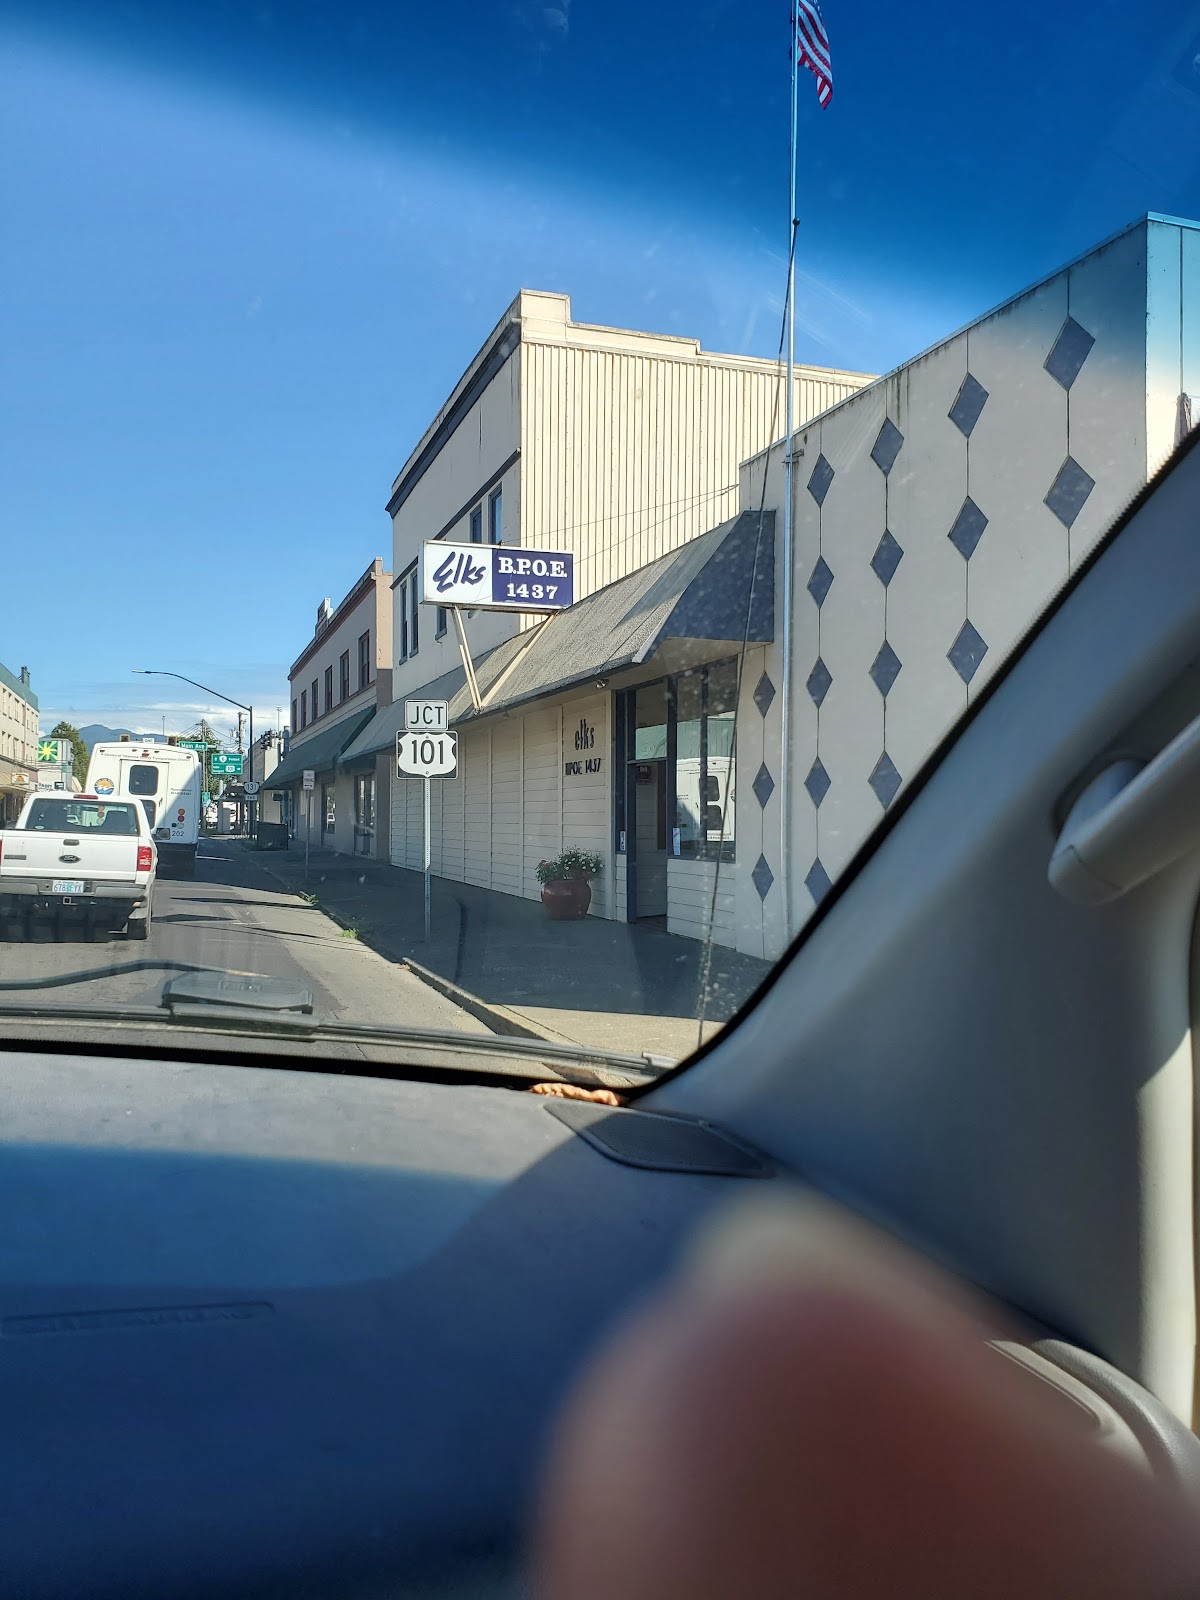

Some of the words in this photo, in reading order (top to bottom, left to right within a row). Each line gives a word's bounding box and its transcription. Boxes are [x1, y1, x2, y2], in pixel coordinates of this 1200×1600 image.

[433, 551, 486, 593] Elks
[498, 557, 568, 578] B.P.O.E.
[507, 583, 558, 600] 1437
[410, 706, 444, 725] JCT
[575, 719, 595, 750] elks
[411, 739, 444, 765] 101
